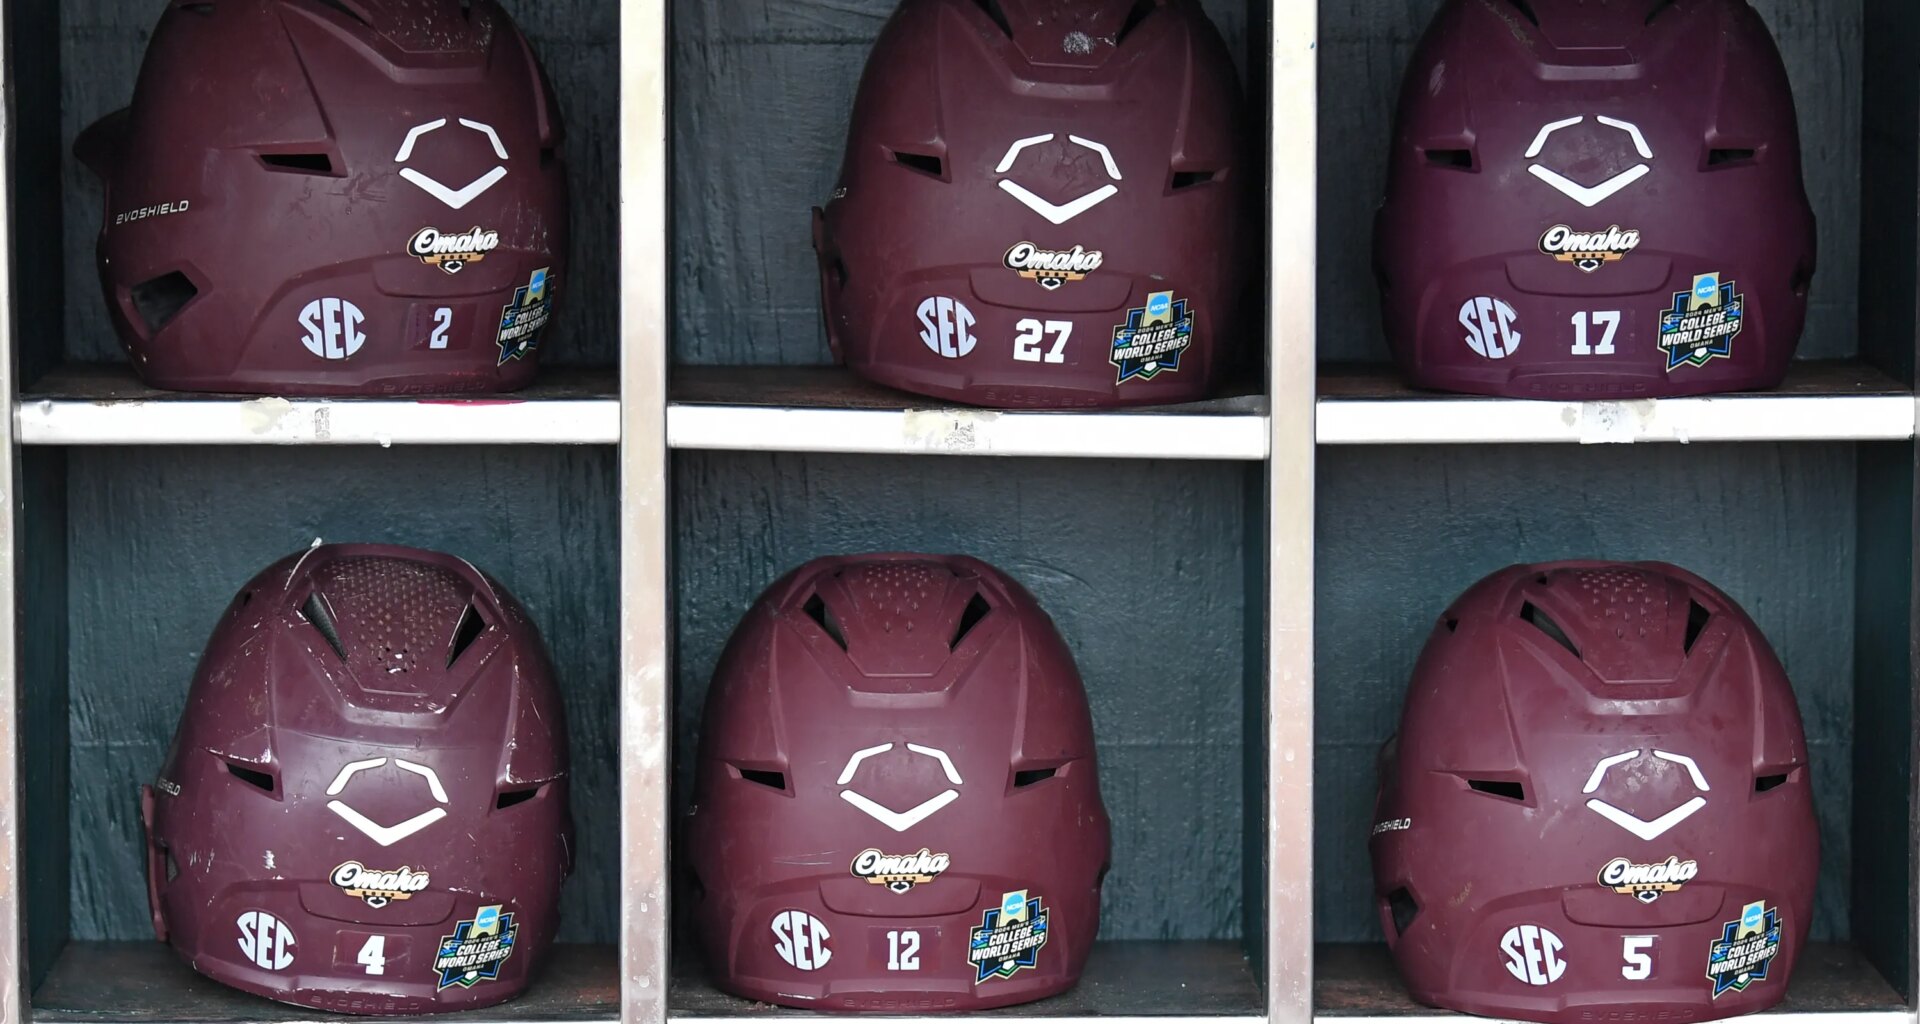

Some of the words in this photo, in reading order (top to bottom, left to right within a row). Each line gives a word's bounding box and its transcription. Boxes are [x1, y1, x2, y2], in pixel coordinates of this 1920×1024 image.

[414, 227, 499, 254] Omaha
[1543, 226, 1640, 251] Omaha
[1008, 243, 1103, 271] Omaha
[298, 297, 367, 359] SEC
[429, 307, 453, 349] 2
[500, 323, 529, 342] WORLD
[916, 296, 977, 358] SEC
[1458, 296, 1521, 359] SEC
[1571, 310, 1621, 355] 17
[1661, 329, 1702, 347] WORLD
[1702, 319, 1740, 340] SERIES
[1679, 311, 1727, 332] COLLEGE
[1013, 318, 1073, 364] 27
[1113, 345, 1153, 361] WORLD
[1153, 335, 1190, 354] SERIES
[1131, 327, 1178, 347] COLLEGE
[1689, 339, 1714, 349] OMAHA
[854, 849, 950, 875] Omaha
[1603, 858, 1698, 885] Omaha
[334, 862, 430, 891] Omaha
[236, 911, 296, 970] SEC
[456, 939, 502, 956] COLLEGE
[771, 910, 832, 971] SEC
[971, 943, 1011, 961] WORLD
[1010, 932, 1045, 953] SERIES
[988, 925, 1034, 947] COLLEGE
[1727, 937, 1769, 959] COLLEGE
[357, 935, 386, 975] 4
[437, 954, 477, 969] WORLD
[475, 946, 511, 964] SERIES
[886, 930, 920, 971] 12
[1500, 924, 1567, 986] SEC
[1622, 936, 1654, 981] 5
[1709, 956, 1745, 975] WORLD
[1745, 944, 1777, 965] SERIES
